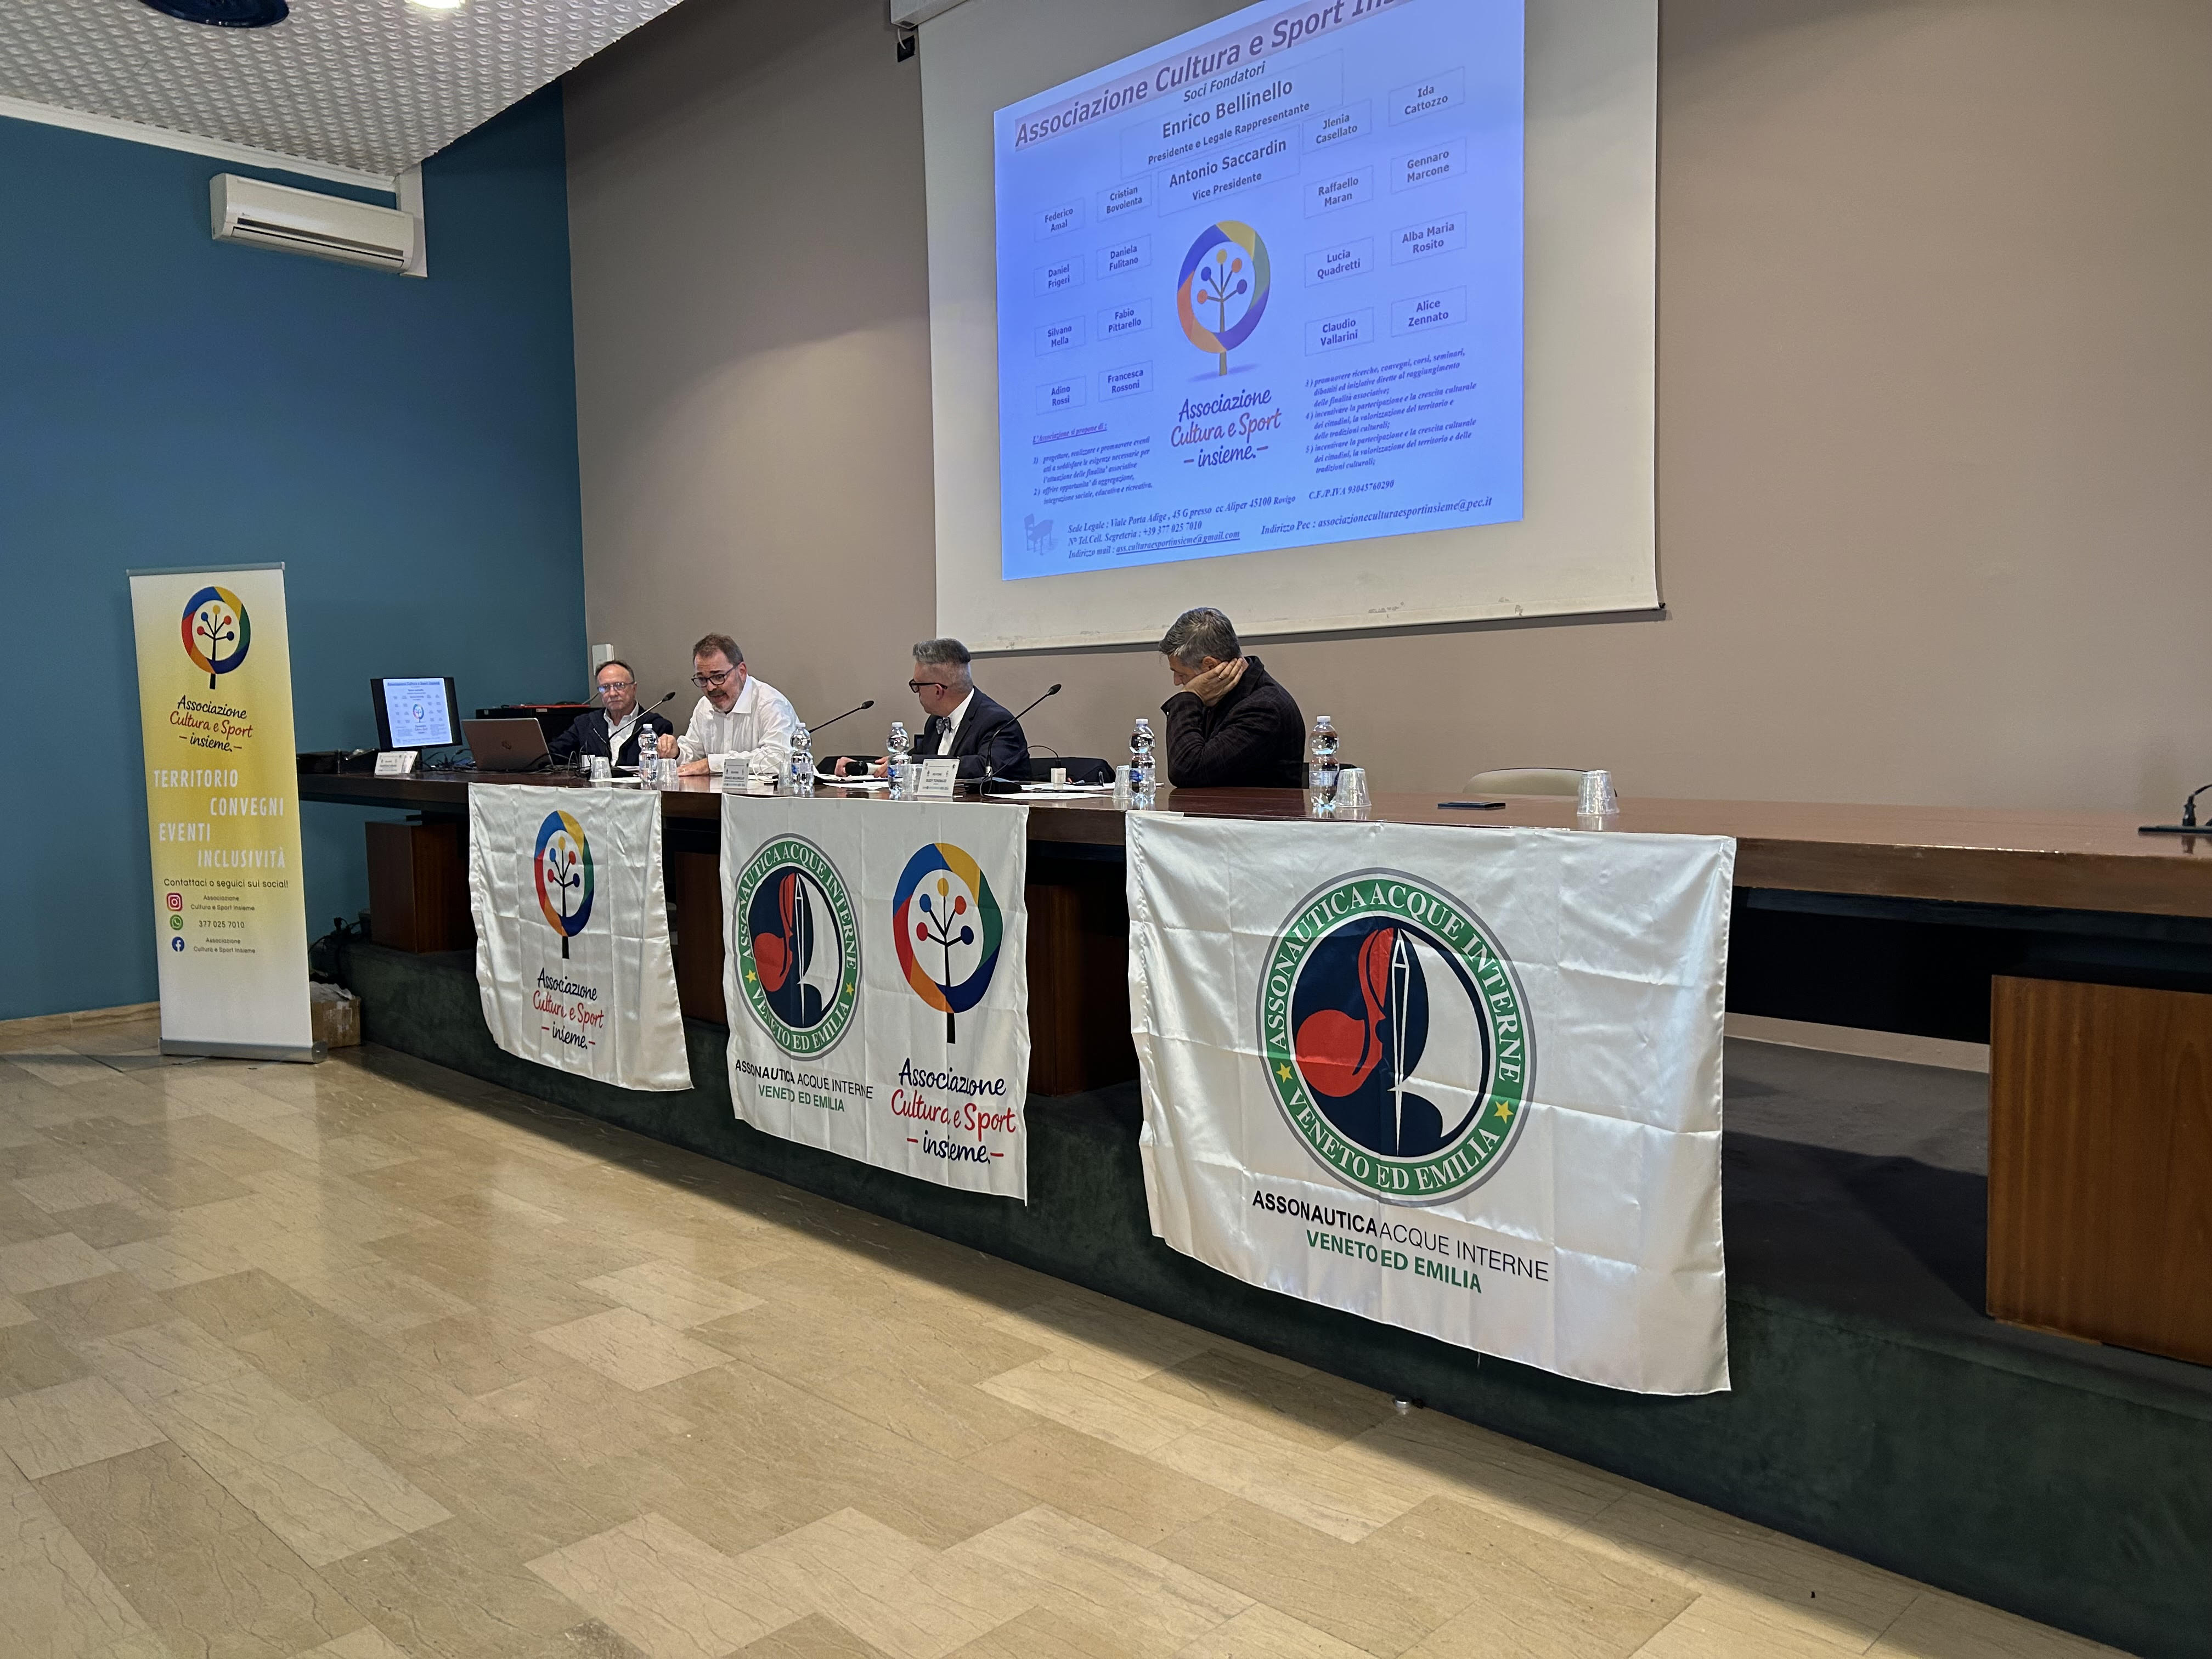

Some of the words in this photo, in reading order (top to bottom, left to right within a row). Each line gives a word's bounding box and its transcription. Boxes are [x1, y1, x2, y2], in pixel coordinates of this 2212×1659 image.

[1015, 82, 1148, 147] Associazione
[1156, 44, 1241, 92] Cultura
[1249, 35, 1263, 55] e
[1272, 1, 1344, 48] Sport
[1183, 83, 1207, 103] Soci
[1210, 61, 1266, 92] Fondatori
[1418, 86, 1434, 98] Ida
[1163, 111, 1210, 138] Enrico
[1216, 81, 1293, 119] Bellinello
[1405, 95, 1448, 115] Cattozzo
[1148, 142, 1193, 164] Presidente
[1203, 129, 1232, 146] Legale
[1235, 103, 1310, 136] Rappresentante
[1316, 125, 1357, 144] Casellato
[1170, 162, 1218, 188] Antonio
[1222, 140, 1286, 170] Saccardin
[1407, 151, 1449, 169] Gennaro
[1407, 164, 1449, 182] Marcone
[1110, 187, 1138, 201] Cristian
[1193, 189, 1210, 200] Vice
[1214, 173, 1262, 194] Presidente
[1318, 177, 1358, 195] Raffaello
[1107, 197, 1142, 214] Bovolenta
[1324, 193, 1352, 206] Maran
[1045, 208, 1073, 222] Federico
[1402, 231, 1424, 243] Alba
[1427, 222, 1454, 238] Maria
[1110, 245, 1137, 259] Daniela
[1413, 240, 1444, 253] Rosito
[1109, 257, 1138, 270] Fulitano
[1327, 250, 1351, 263] Lucia
[1048, 264, 1069, 278] Daniel
[1318, 258, 1361, 279] Quadretti
[1048, 275, 1070, 289] Frigeri
[1115, 308, 1135, 320] Fabio
[1417, 300, 1441, 312] Alice
[1108, 318, 1141, 332] Pittarello
[1323, 318, 1356, 333] Claudio
[1408, 312, 1448, 327] Zennato
[1047, 325, 1072, 337] Silvano
[1321, 329, 1358, 346] Vallarini
[1051, 336, 1069, 347] Mella
[1108, 370, 1143, 383] Francesca
[1051, 385, 1070, 396] Adino
[1111, 380, 1139, 393] Rossoni
[1052, 395, 1070, 406] Rossi
[1179, 390, 1272, 422] Associazione
[1171, 421, 1224, 447] Cultura
[1228, 422, 1236, 437] e
[1239, 408, 1282, 443] Sport
[1316, 462, 1344, 473] tradizioni
[1068, 524, 1082, 533] Sede
[1084, 521, 1104, 532] Legale
[1111, 518, 1126, 527] Viale
[1128, 516, 1146, 526] Porta
[1183, 509, 1188, 517] G
[1189, 507, 1212, 518] presso
[1225, 500, 1248, 513] Aliper
[1249, 496, 1272, 508] 45100
[1273, 495, 1296, 505] Rovigo
[1261, 522, 1294, 534] Indirizzo
[1296, 520, 1311, 530] Pec
[1318, 496, 1492, 528] associazioneculturaesportinsieme@pec.it
[1104, 530, 1137, 543] Segreteria
[1143, 527, 1156, 536] +39
[1171, 522, 1183, 533] 025
[1069, 549, 1095, 558] Indirizzo
[1097, 546, 1111, 555] mail
[177, 695, 247, 719] Associazione
[170, 711, 211, 731] Cultura
[213, 723, 220, 732] e
[221, 720, 253, 741] Sport
[154, 769, 238, 788] TERRITORIO
[210, 798, 284, 816] CONVEGNI
[159, 823, 211, 842] EVENTI
[198, 847, 285, 868] INCLUSIVITÀ
[164, 878, 206, 887] Contattaci
[217, 879, 245, 889] seguici
[262, 880, 288, 888] social!
[783, 844, 826, 878] ACQUE
[826, 874, 856, 969] INTERNE
[1268, 885, 1367, 1051] ASSONAUTICA
[1370, 882, 1466, 941] ACQUE
[1461, 932, 1521, 1084] INTERNE
[569, 1007, 575, 1021] e
[577, 1002, 604, 1032] Sport
[751, 987, 791, 1049] VENETO
[793, 1034, 810, 1050] ED
[812, 1001, 849, 1049] EMILIA
[735, 1059, 794, 1084] ASSONAUTICA
[798, 1073, 830, 1090] ACQUE
[832, 1079, 873, 1099] INTERNE
[899, 1058, 1007, 1096] Associazione
[758, 1084, 795, 1103] VENETO
[798, 1091, 811, 1105] ED
[814, 1093, 845, 1112] EMILIA
[891, 1088, 951, 1124] Cultura
[953, 1110, 961, 1121] e
[963, 1102, 1016, 1141] Sport
[1289, 1086, 1370, 1179] VENETO
[1376, 1165, 1409, 1190] ED
[1418, 1127, 1501, 1190] EMILIA
[1252, 1190, 1377, 1237] ASSONAUTICA
[1379, 1222, 1449, 1256] ACQUE
[1457, 1240, 1549, 1282] INTERNE
[1306, 1229, 1378, 1262] VENETO
[1380, 1249, 1408, 1270] ED
[1414, 1257, 1482, 1294] EMILIA
